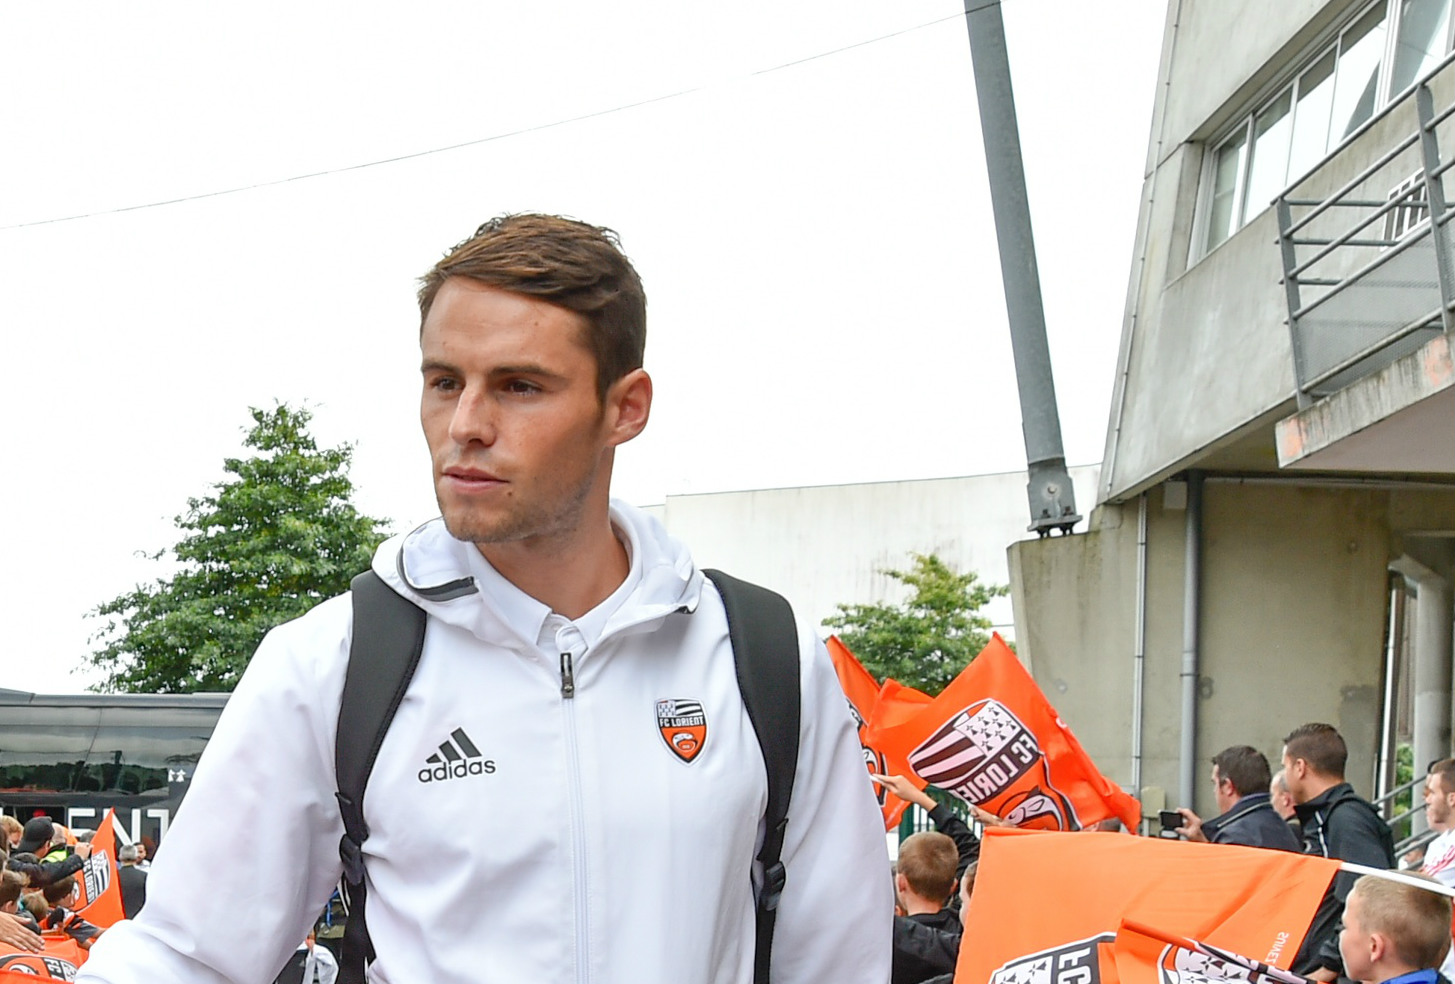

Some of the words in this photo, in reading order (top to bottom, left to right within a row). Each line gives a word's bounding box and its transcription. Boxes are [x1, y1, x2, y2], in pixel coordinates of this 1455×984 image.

[659, 718, 671, 728] FC
[671, 716, 704, 727] LORIENT
[418, 759, 496, 783] adidas
